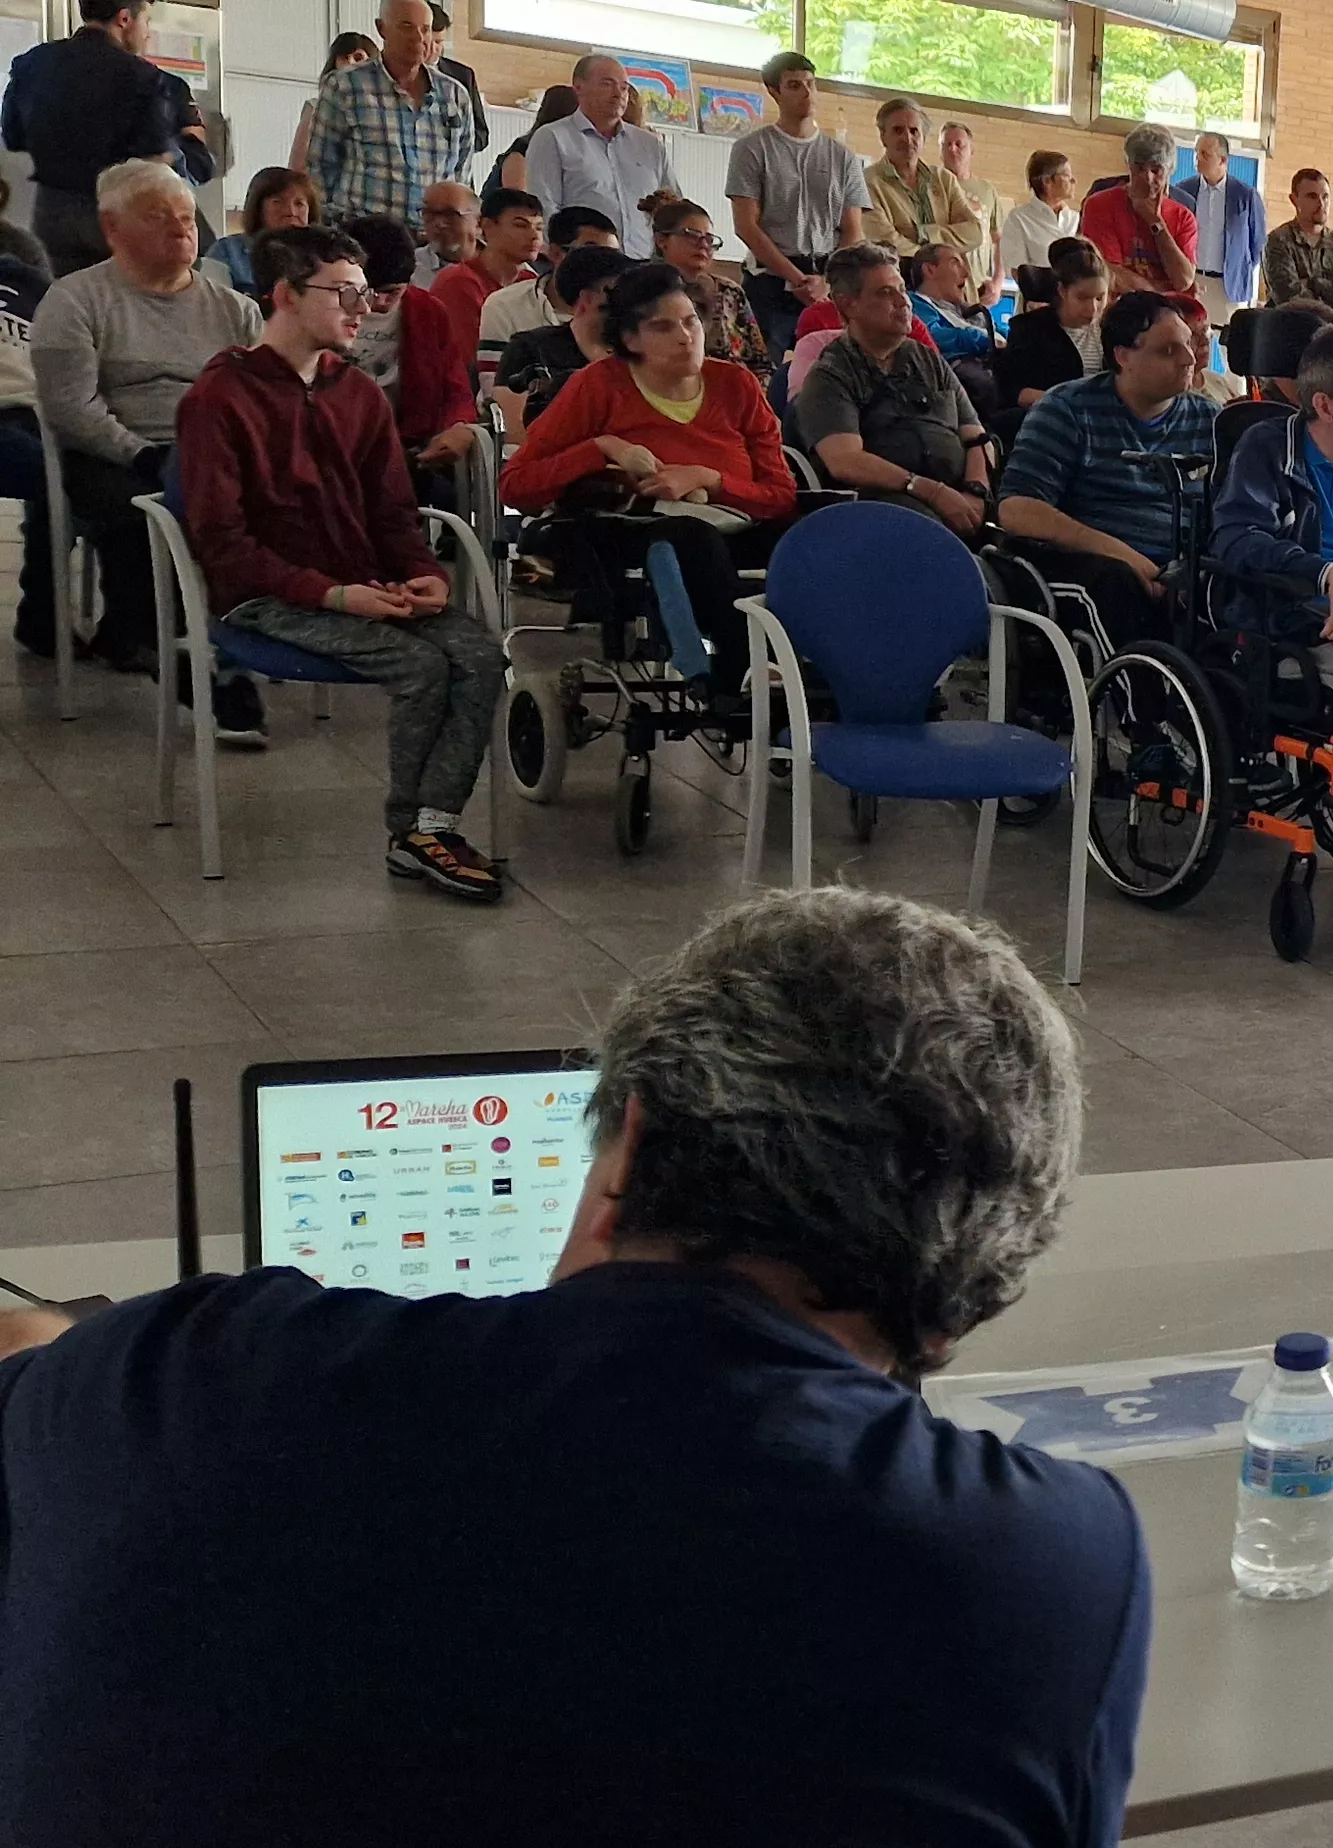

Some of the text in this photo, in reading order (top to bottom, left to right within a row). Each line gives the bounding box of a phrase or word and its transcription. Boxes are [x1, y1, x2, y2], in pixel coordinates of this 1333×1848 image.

[0, 314, 31, 342] TE
[404, 1098, 468, 1117] Marcha
[407, 1115, 468, 1125] ASPACE HUESCA
